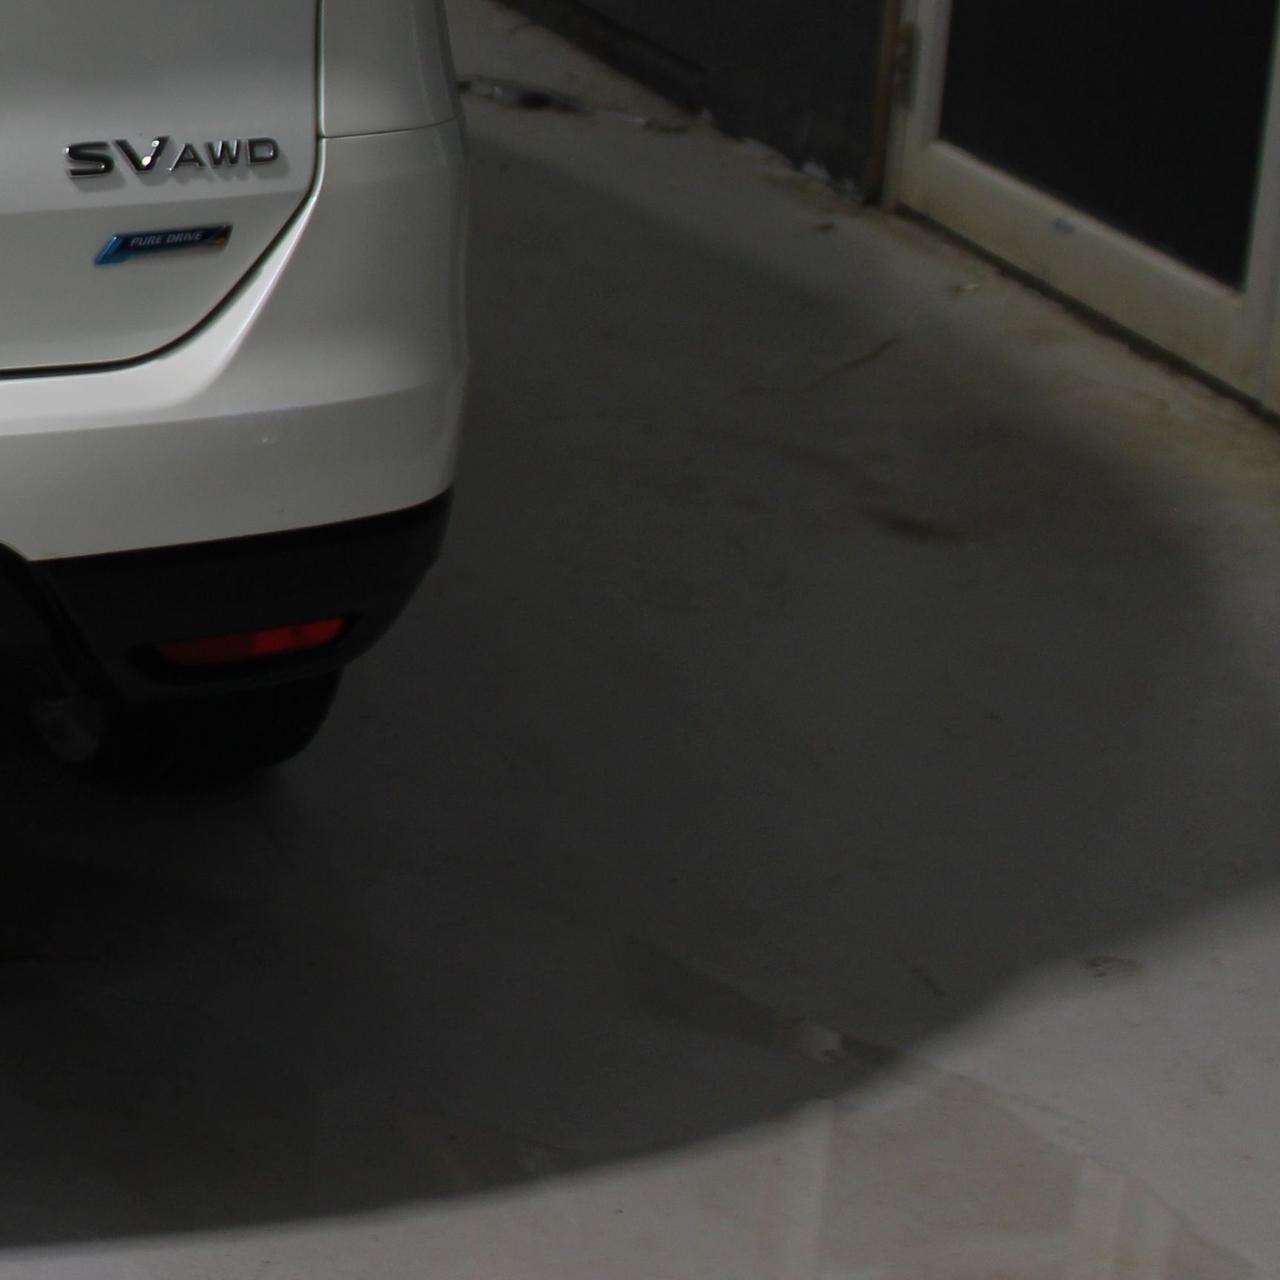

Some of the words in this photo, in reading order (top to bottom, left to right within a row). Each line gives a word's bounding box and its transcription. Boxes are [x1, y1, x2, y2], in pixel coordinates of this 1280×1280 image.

[64, 136, 170, 178] SV
[169, 137, 280, 171] AWD
[130, 233, 163, 247] PURE
[166, 230, 203, 244] DRIVE
